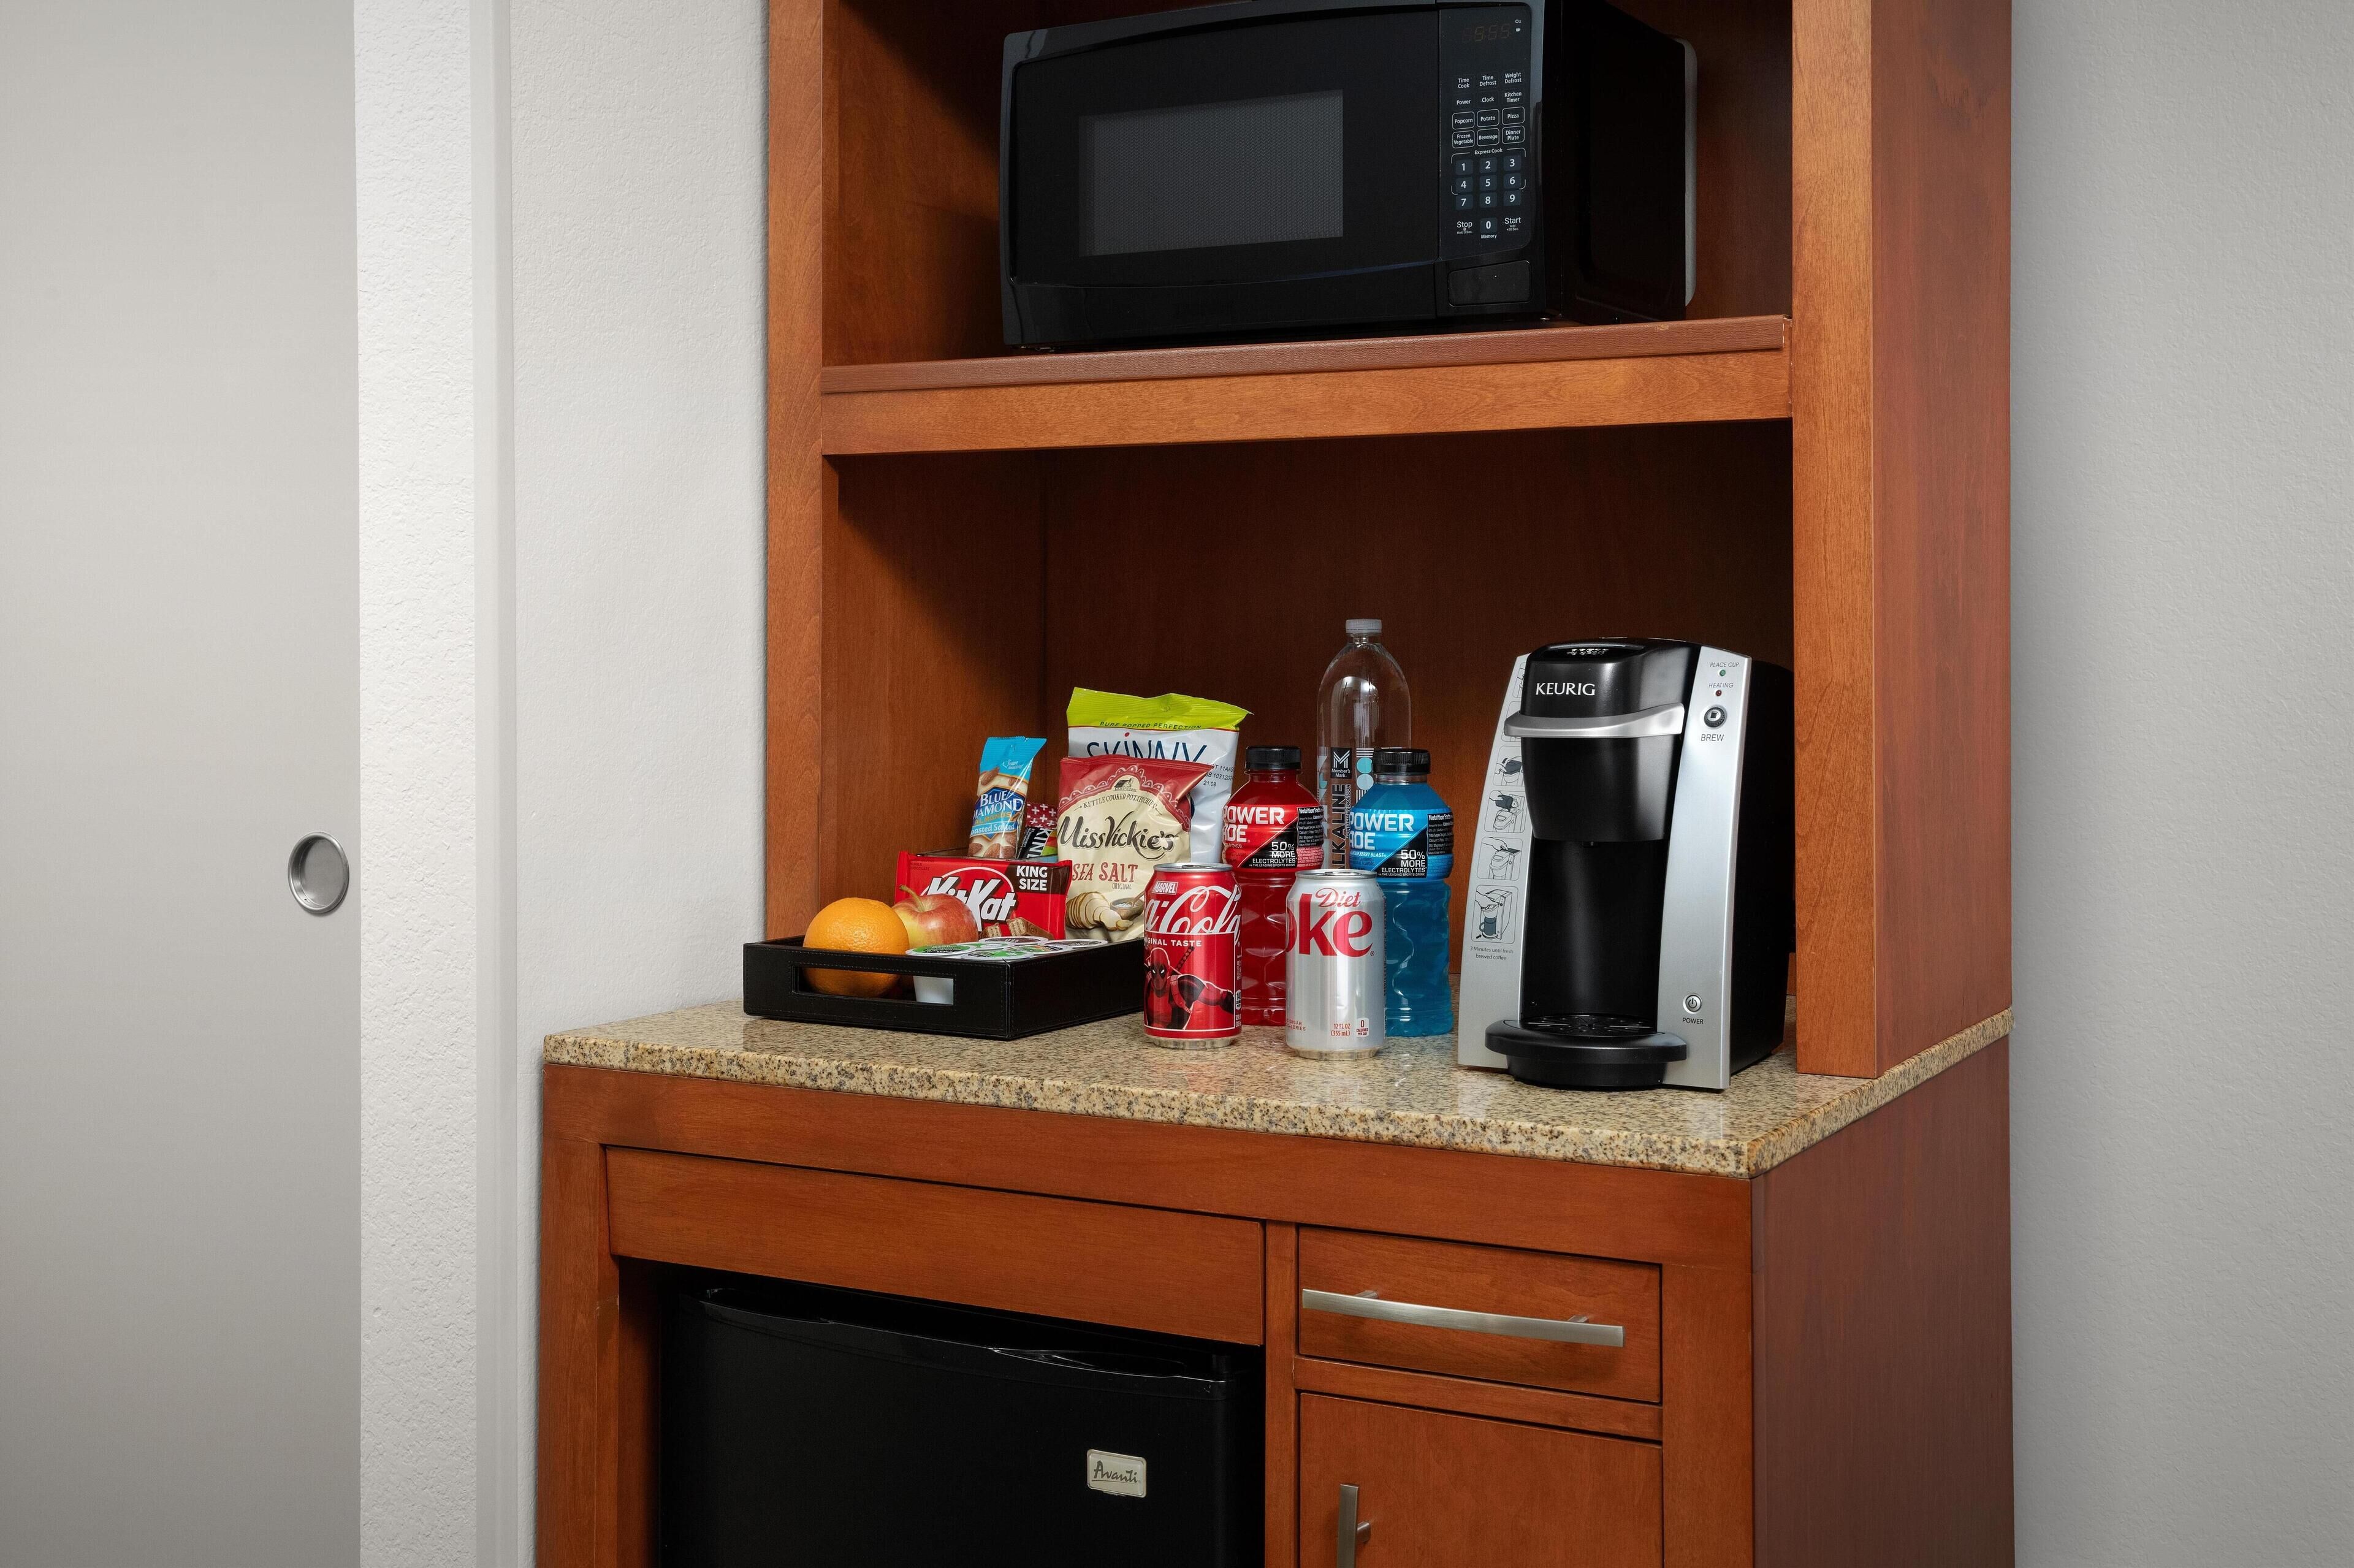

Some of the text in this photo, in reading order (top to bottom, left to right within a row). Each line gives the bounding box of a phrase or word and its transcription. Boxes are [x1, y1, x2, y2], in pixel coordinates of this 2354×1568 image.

[1536, 683, 1595, 696] KEURIG
[980, 790, 1008, 807] BLUE
[1083, 797, 1105, 809] KETTLE
[973, 798, 1024, 820] IAMOND
[1222, 805, 1285, 824] POWER
[1349, 812, 1414, 831] POWER
[971, 824, 992, 835] oasted
[1105, 811, 1179, 860] Vickie's
[1271, 842, 1295, 851] 50%
[1401, 850, 1425, 859] 50%
[1016, 866, 1048, 878] KING
[1072, 862, 1138, 883] SEA SALT
[1019, 878, 1047, 891] SIZE
[1154, 881, 1176, 894] MARVEL
[1316, 888, 1361, 907] Diet
[1286, 893, 1373, 957] oke
[1360, 1019, 1365, 1028] 0
[1094, 1460, 1138, 1483] Avanti
